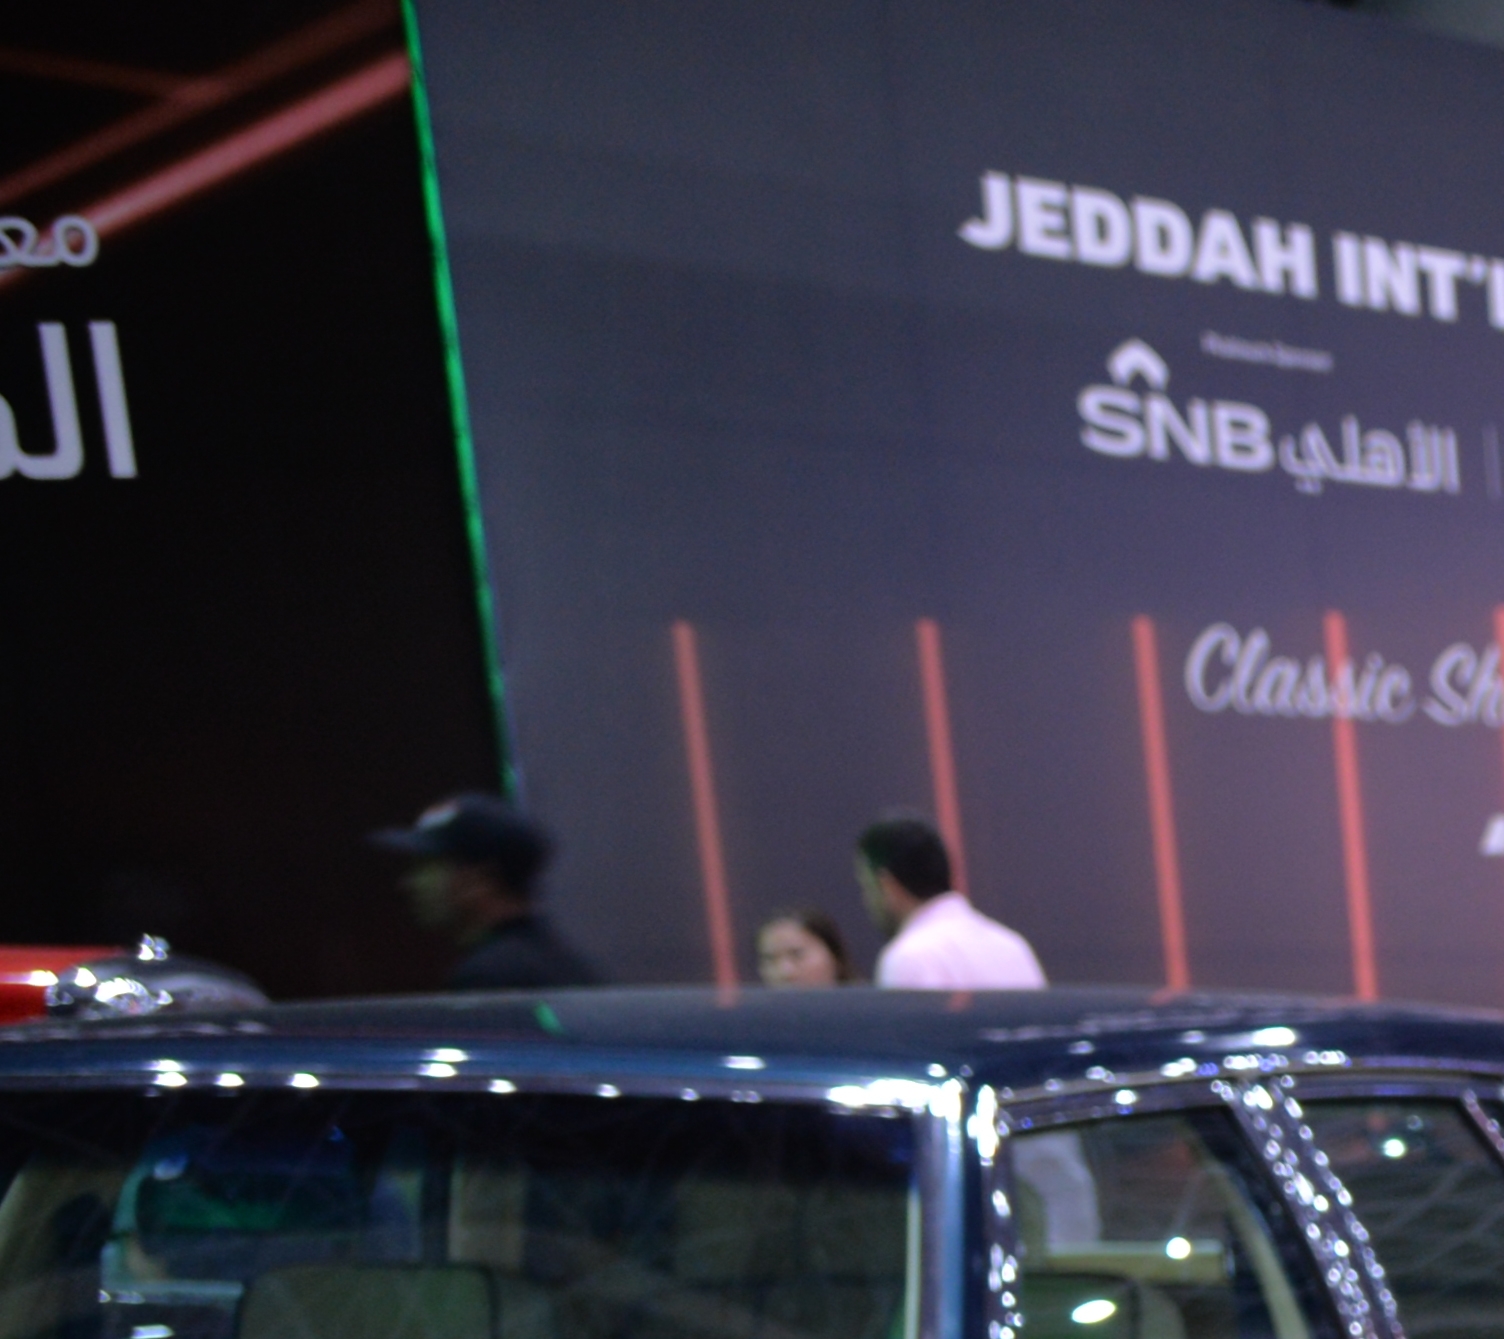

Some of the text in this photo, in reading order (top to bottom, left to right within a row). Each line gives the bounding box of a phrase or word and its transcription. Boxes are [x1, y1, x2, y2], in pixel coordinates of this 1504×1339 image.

[958, 169, 1318, 300] JEDDAH
[1077, 384, 1274, 472] SNB
[1184, 622, 1416, 724] Classic
